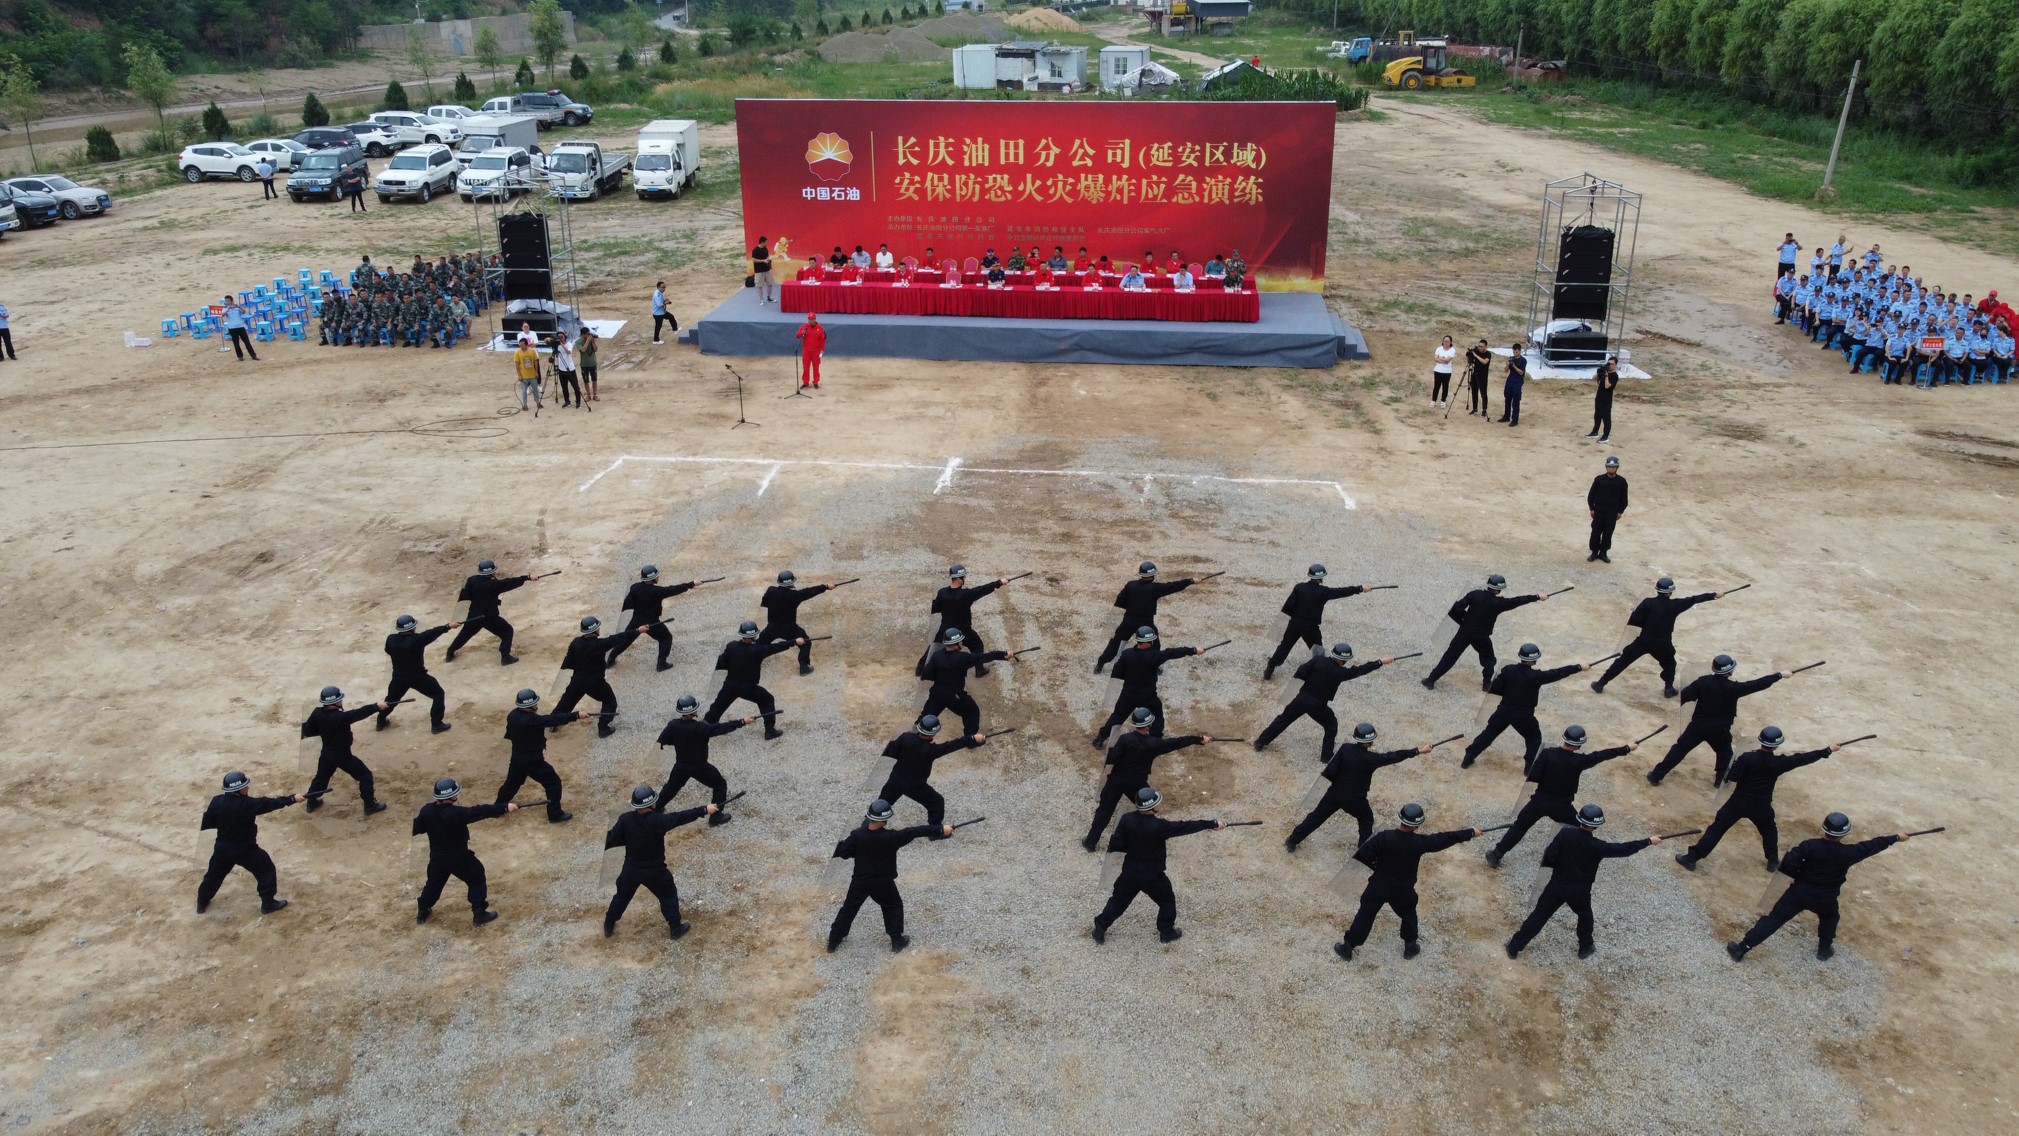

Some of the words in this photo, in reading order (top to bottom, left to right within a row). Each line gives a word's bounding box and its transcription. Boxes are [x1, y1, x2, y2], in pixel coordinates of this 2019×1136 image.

[802, 186, 861, 201] 中国石油
[894, 172, 1264, 205] 安保防恐火灾爆炸应急演练
